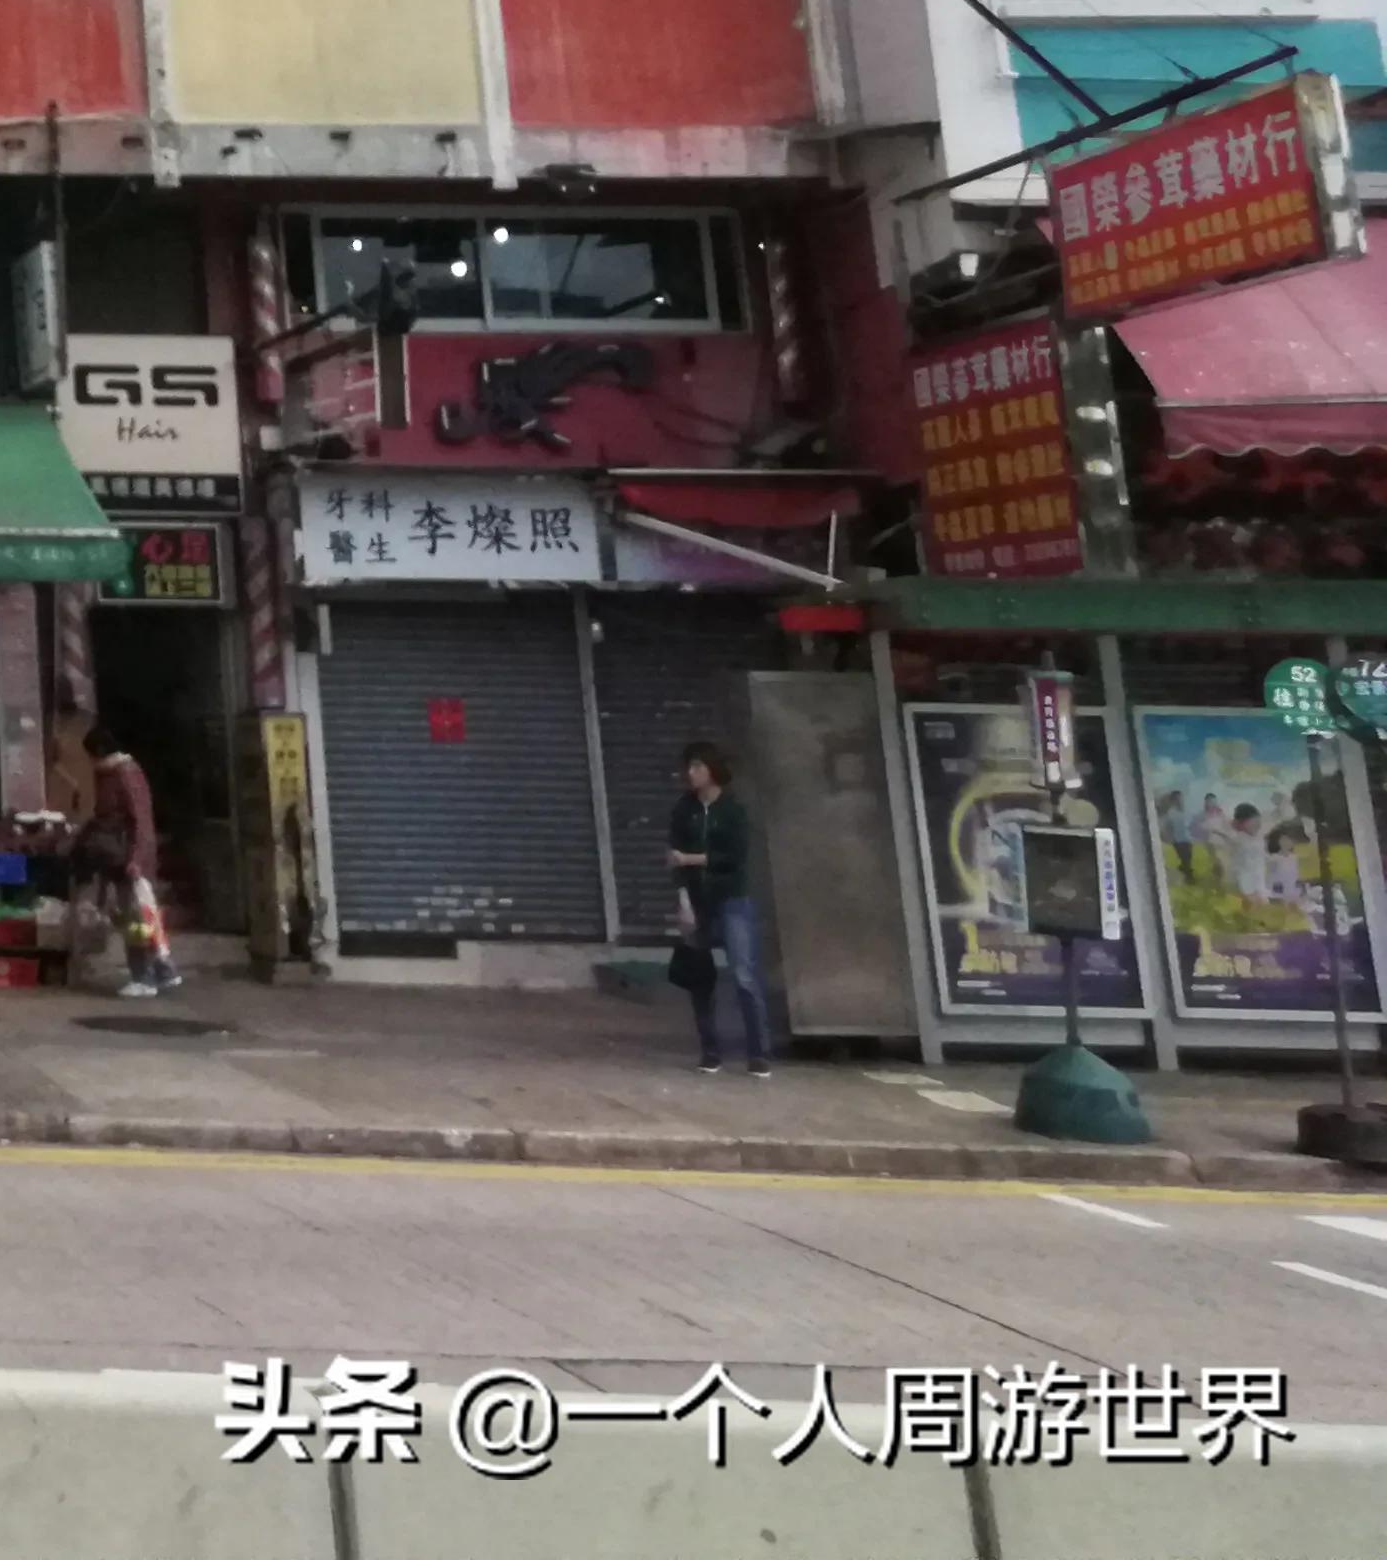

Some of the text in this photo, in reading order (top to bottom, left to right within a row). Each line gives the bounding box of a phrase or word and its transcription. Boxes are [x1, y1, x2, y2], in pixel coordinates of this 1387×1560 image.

[74, 364, 220, 407] GS
[323, 487, 395, 523] 牙科
[407, 500, 581, 556] 李燦照
[326, 529, 398, 565] 醫生
[1290, 665, 1318, 683] 52
